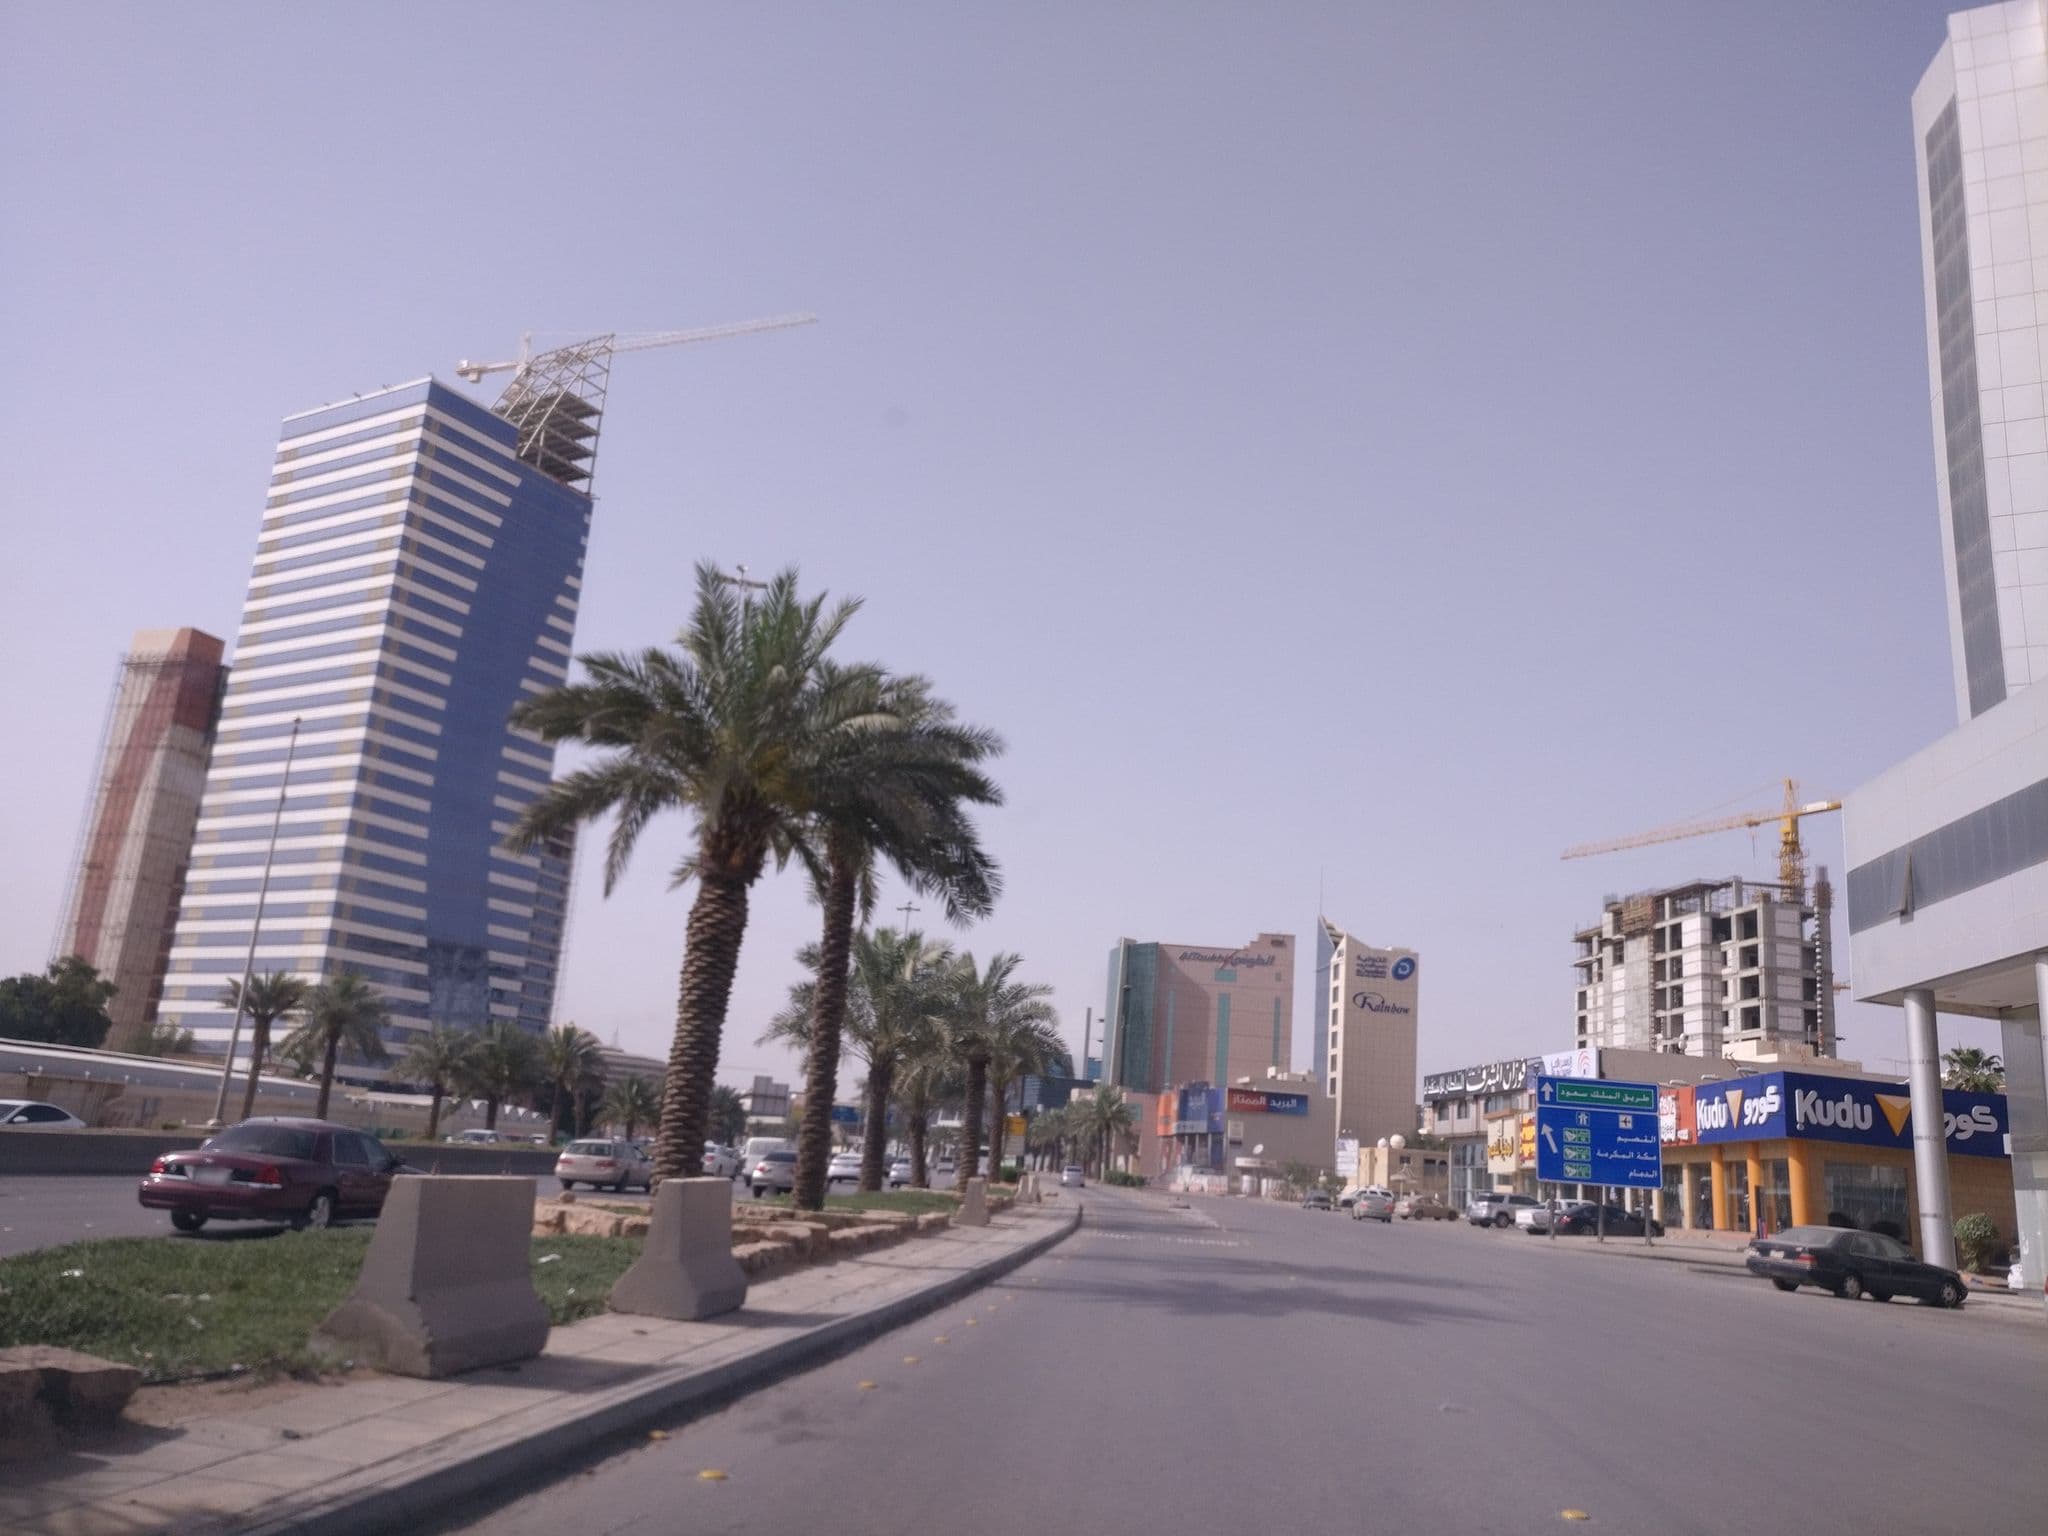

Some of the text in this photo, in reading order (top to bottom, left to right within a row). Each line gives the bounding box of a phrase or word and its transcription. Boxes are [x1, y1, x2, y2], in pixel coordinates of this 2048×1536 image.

[1353, 992, 1409, 1014] Rainbow
[1233, 1094, 1297, 1109] البريد الممتاز
[1560, 1089, 1650, 1103] طريق الملك سعود
[1696, 1096, 1728, 1131] Kudu
[1795, 1089, 1873, 1130] Kudu
[1616, 1134, 1656, 1144] القصيم
[1596, 1149, 1634, 1160] المكرمة
[1636, 1151, 1657, 1161] مكة
[1628, 1169, 1658, 1179] الدمام
